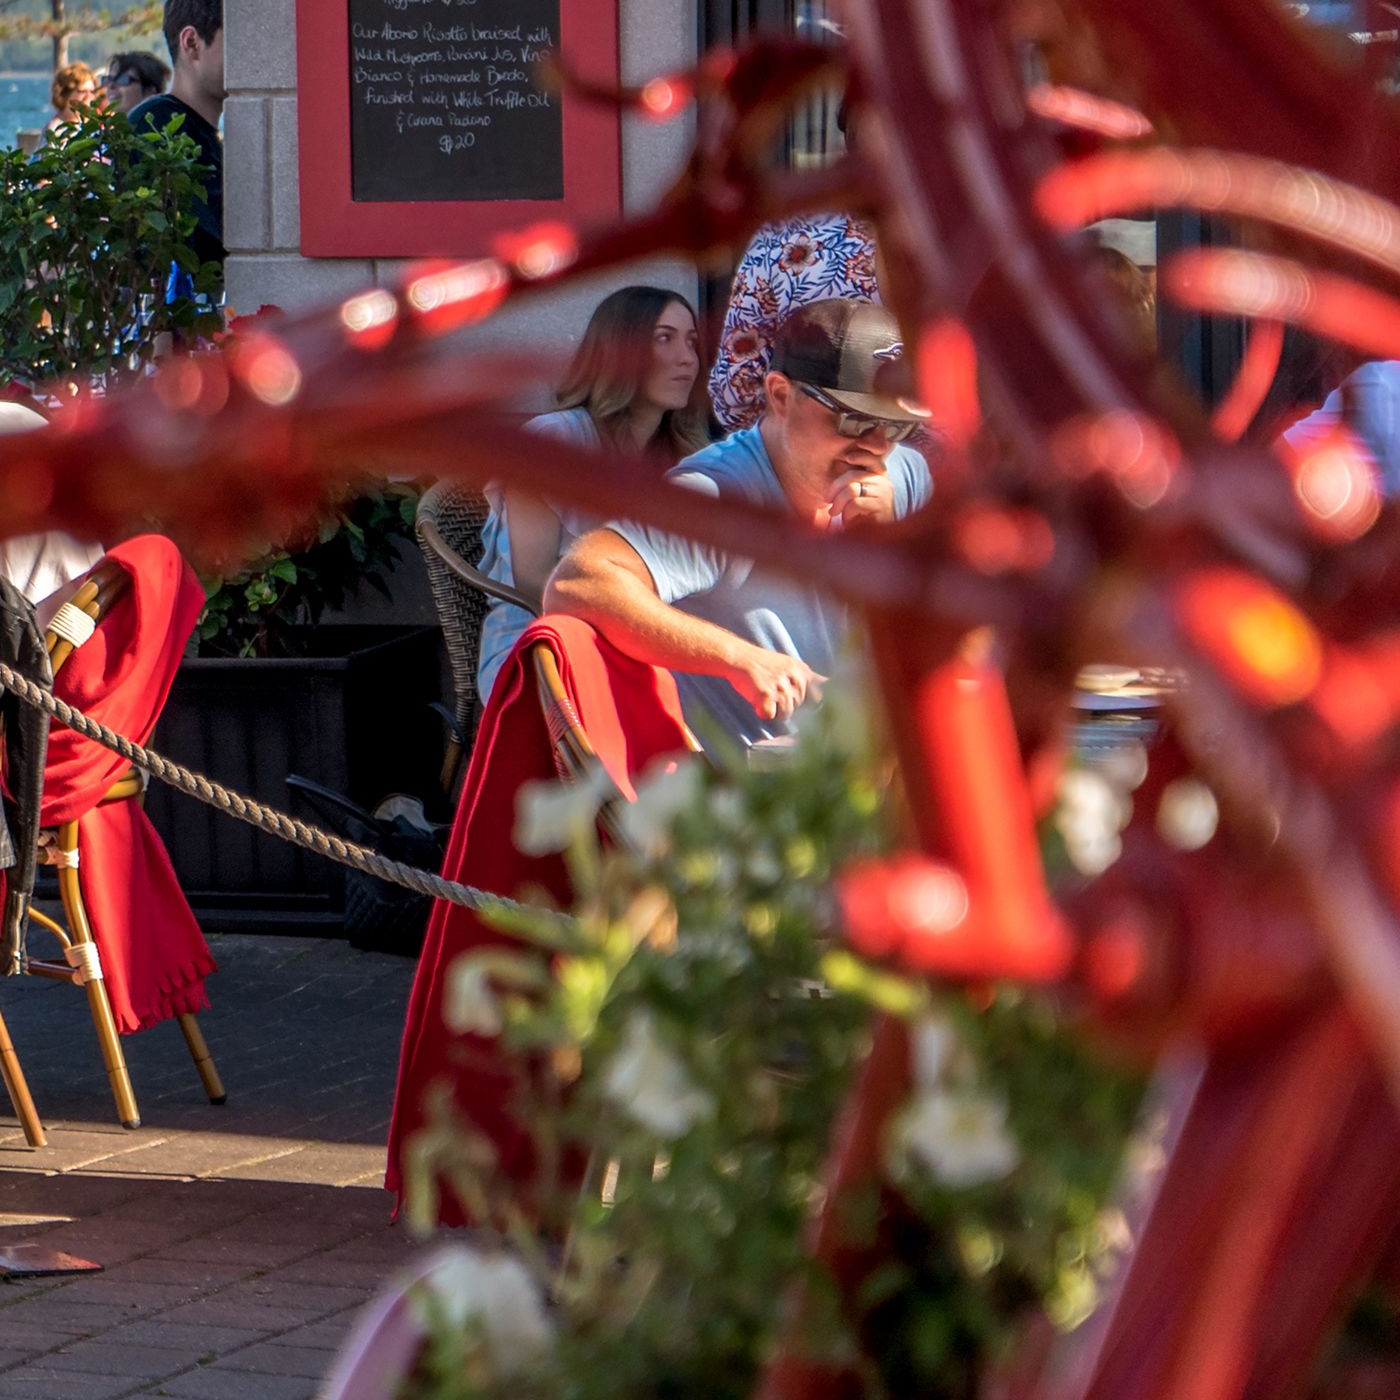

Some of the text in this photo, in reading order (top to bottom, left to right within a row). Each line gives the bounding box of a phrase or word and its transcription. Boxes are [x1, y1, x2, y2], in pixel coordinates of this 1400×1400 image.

[352, 22, 379, 39] Our
[423, 21, 468, 43] Risotto
[527, 25, 553, 47] with
[355, 46, 384, 62] Wild
[355, 66, 402, 84] Bianco
[422, 90, 449, 110] with
[452, 90, 483, 109] White
[483, 88, 526, 111] Truffle
